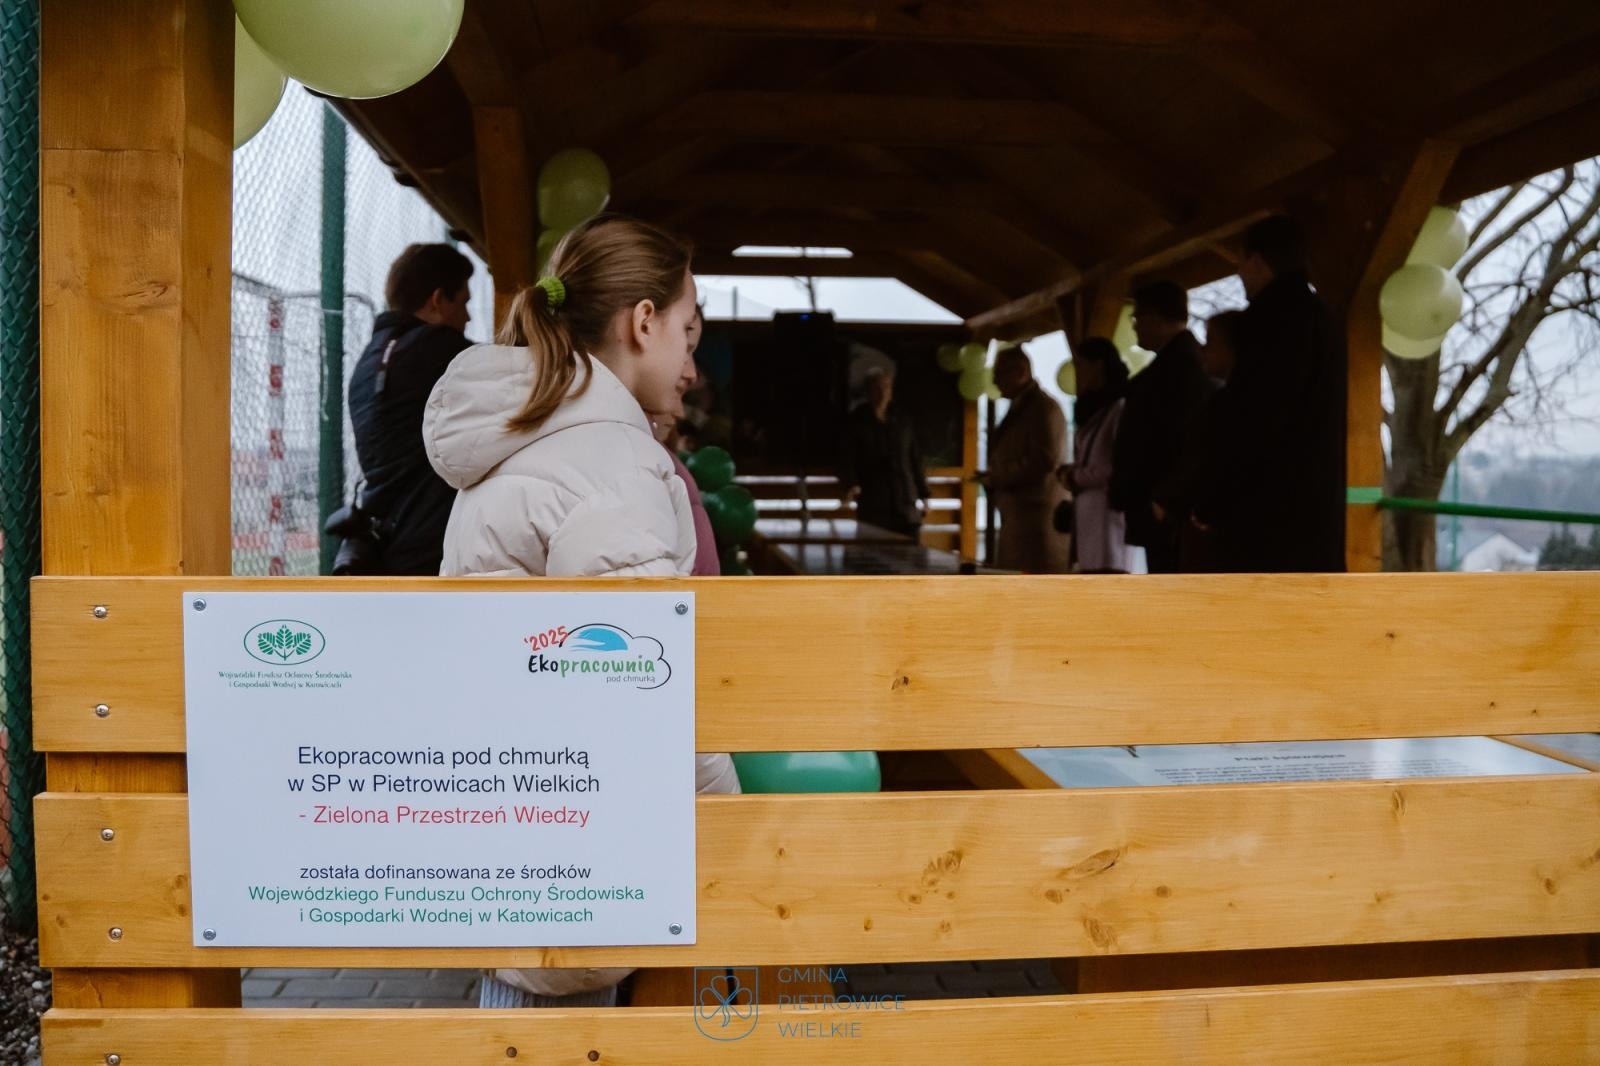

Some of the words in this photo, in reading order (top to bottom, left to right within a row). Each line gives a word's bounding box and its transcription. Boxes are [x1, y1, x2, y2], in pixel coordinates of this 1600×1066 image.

[528, 654, 655, 677] Ekopracownia
[284, 671, 313, 680] Ochrony
[315, 670, 352, 680] Środowiska
[606, 675, 621, 684] pod
[623, 675, 655, 684] chmurką
[299, 747, 445, 769] Ekopracownia
[453, 747, 490, 769] pod
[499, 747, 590, 769] chmurką
[288, 779, 305, 792] w
[312, 774, 340, 792] SP
[349, 779, 366, 792] w
[373, 775, 505, 792] Pietrowicach
[513, 775, 600, 792] Wielkich
[314, 806, 390, 824] Zielona
[398, 806, 507, 824] Przestrzeń
[514, 806, 590, 827] Wiedzy
[300, 865, 360, 880] została
[365, 865, 491, 880] dofinansowana
[496, 868, 516, 880] ze
[521, 864, 592, 880] środków
[249, 886, 379, 904] Wojewódzkiego
[385, 887, 465, 901] Funduszu
[472, 887, 541, 904] Ochrony
[548, 883, 645, 901] Środowiska
[310, 908, 404, 925] Gospodarki
[410, 908, 473, 925] Wodnej
[478, 912, 492, 922] w
[498, 908, 593, 922] Katowicach
